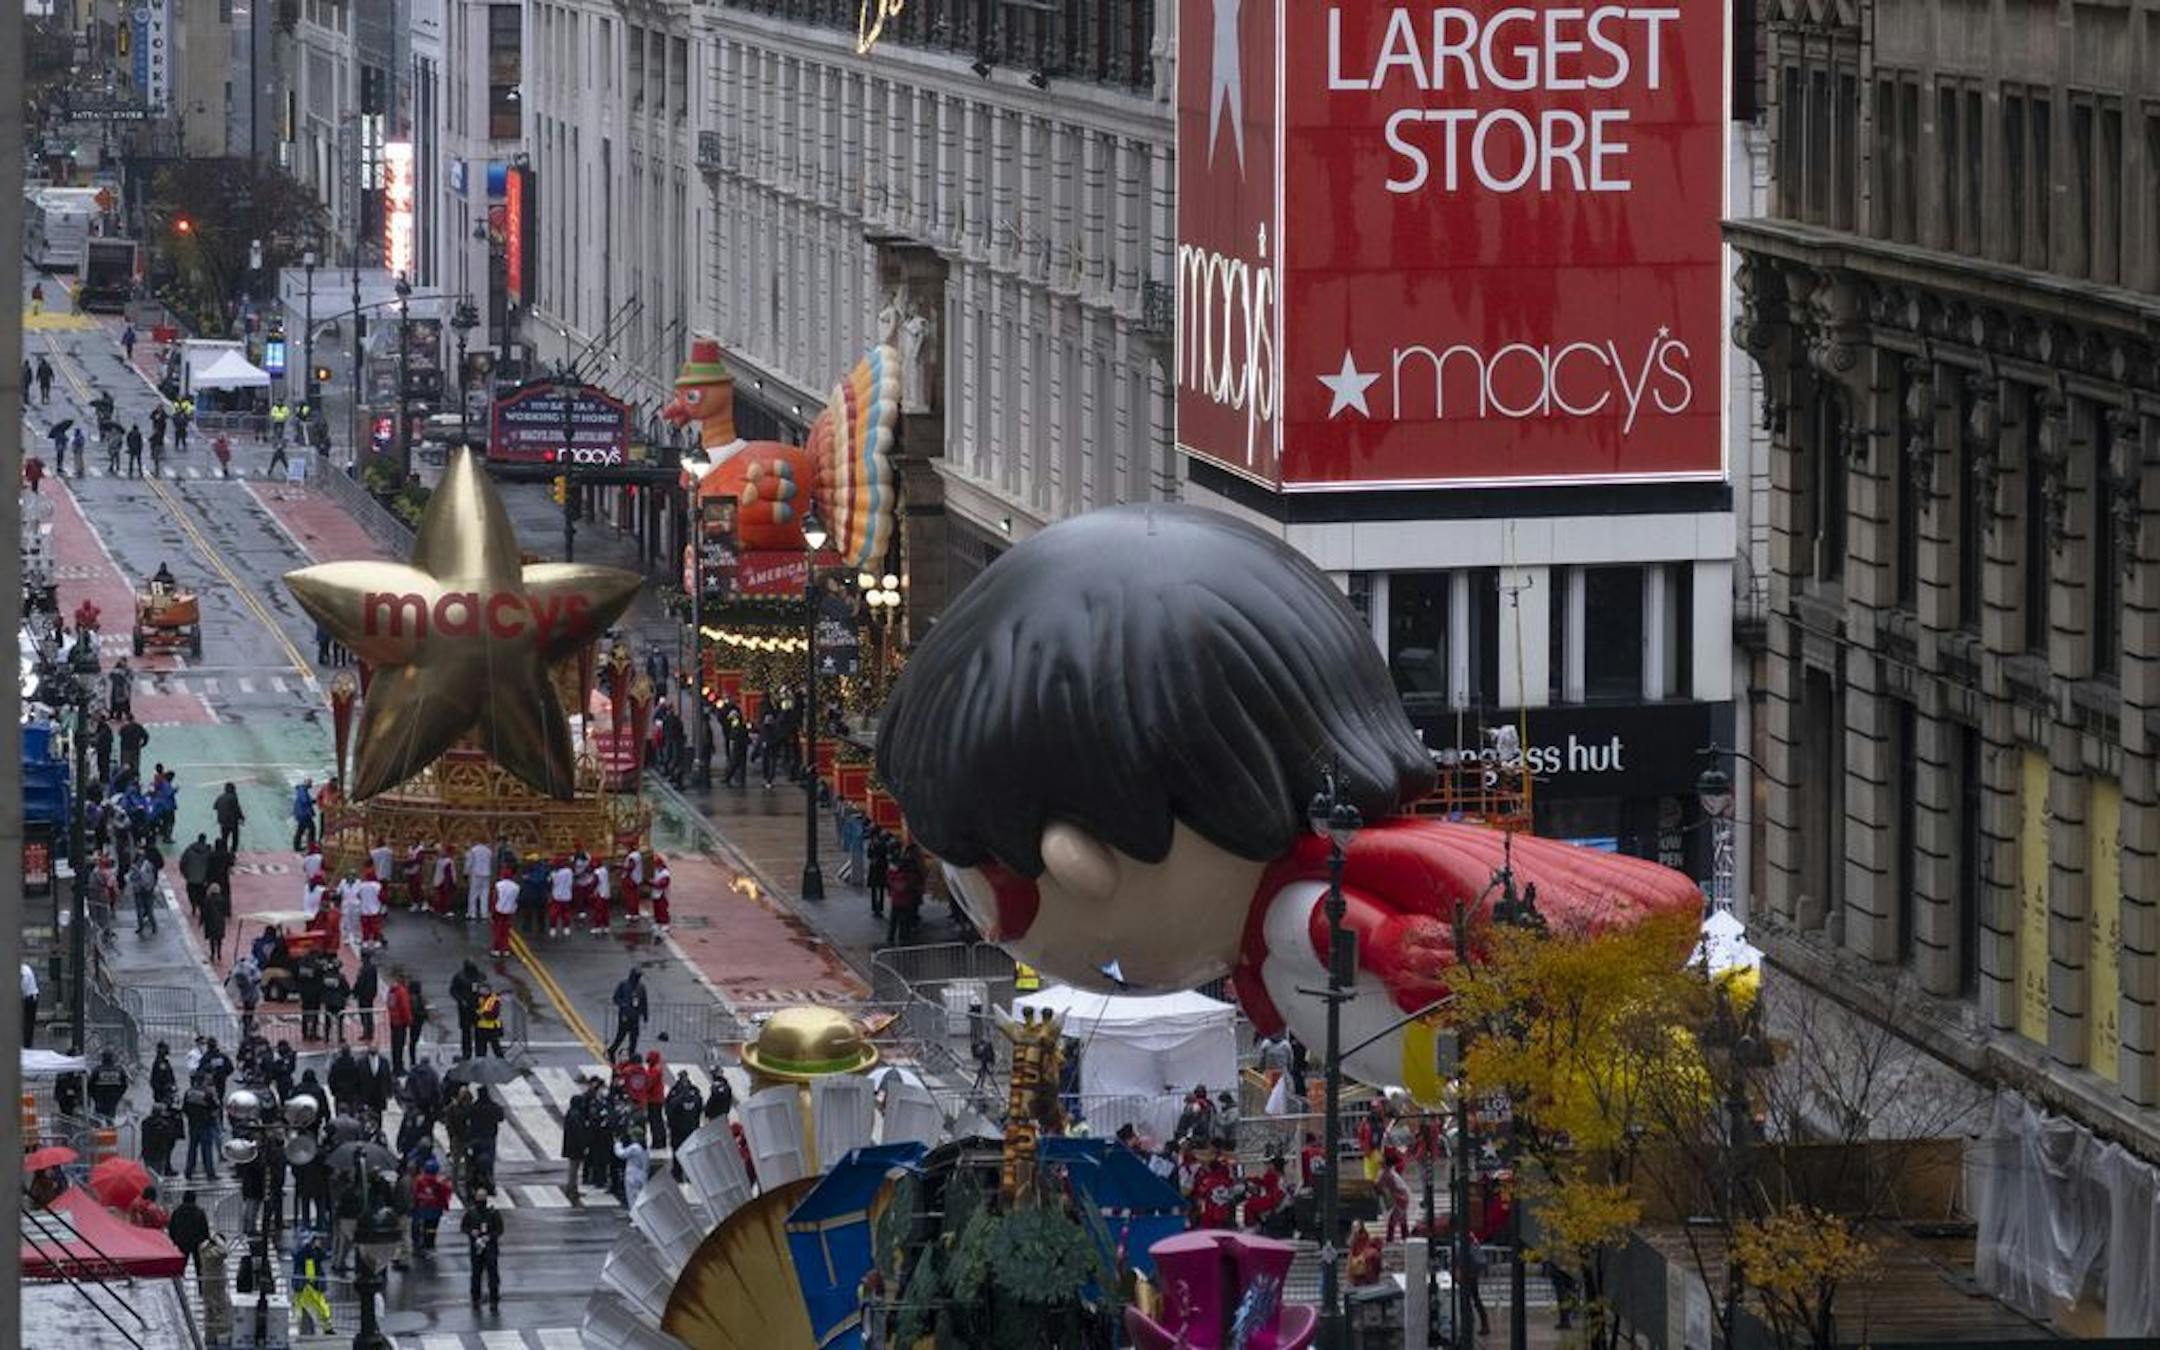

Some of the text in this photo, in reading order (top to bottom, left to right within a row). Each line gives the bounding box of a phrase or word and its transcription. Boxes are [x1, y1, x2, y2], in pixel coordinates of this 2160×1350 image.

[1328, 6, 1680, 91] LARGEST
[1384, 108, 1633, 193] STORE
[1178, 221, 1273, 466] macy's
[1393, 324, 1692, 435] macy's
[505, 412, 560, 421] WORKING
[1568, 735, 1625, 772] hut
